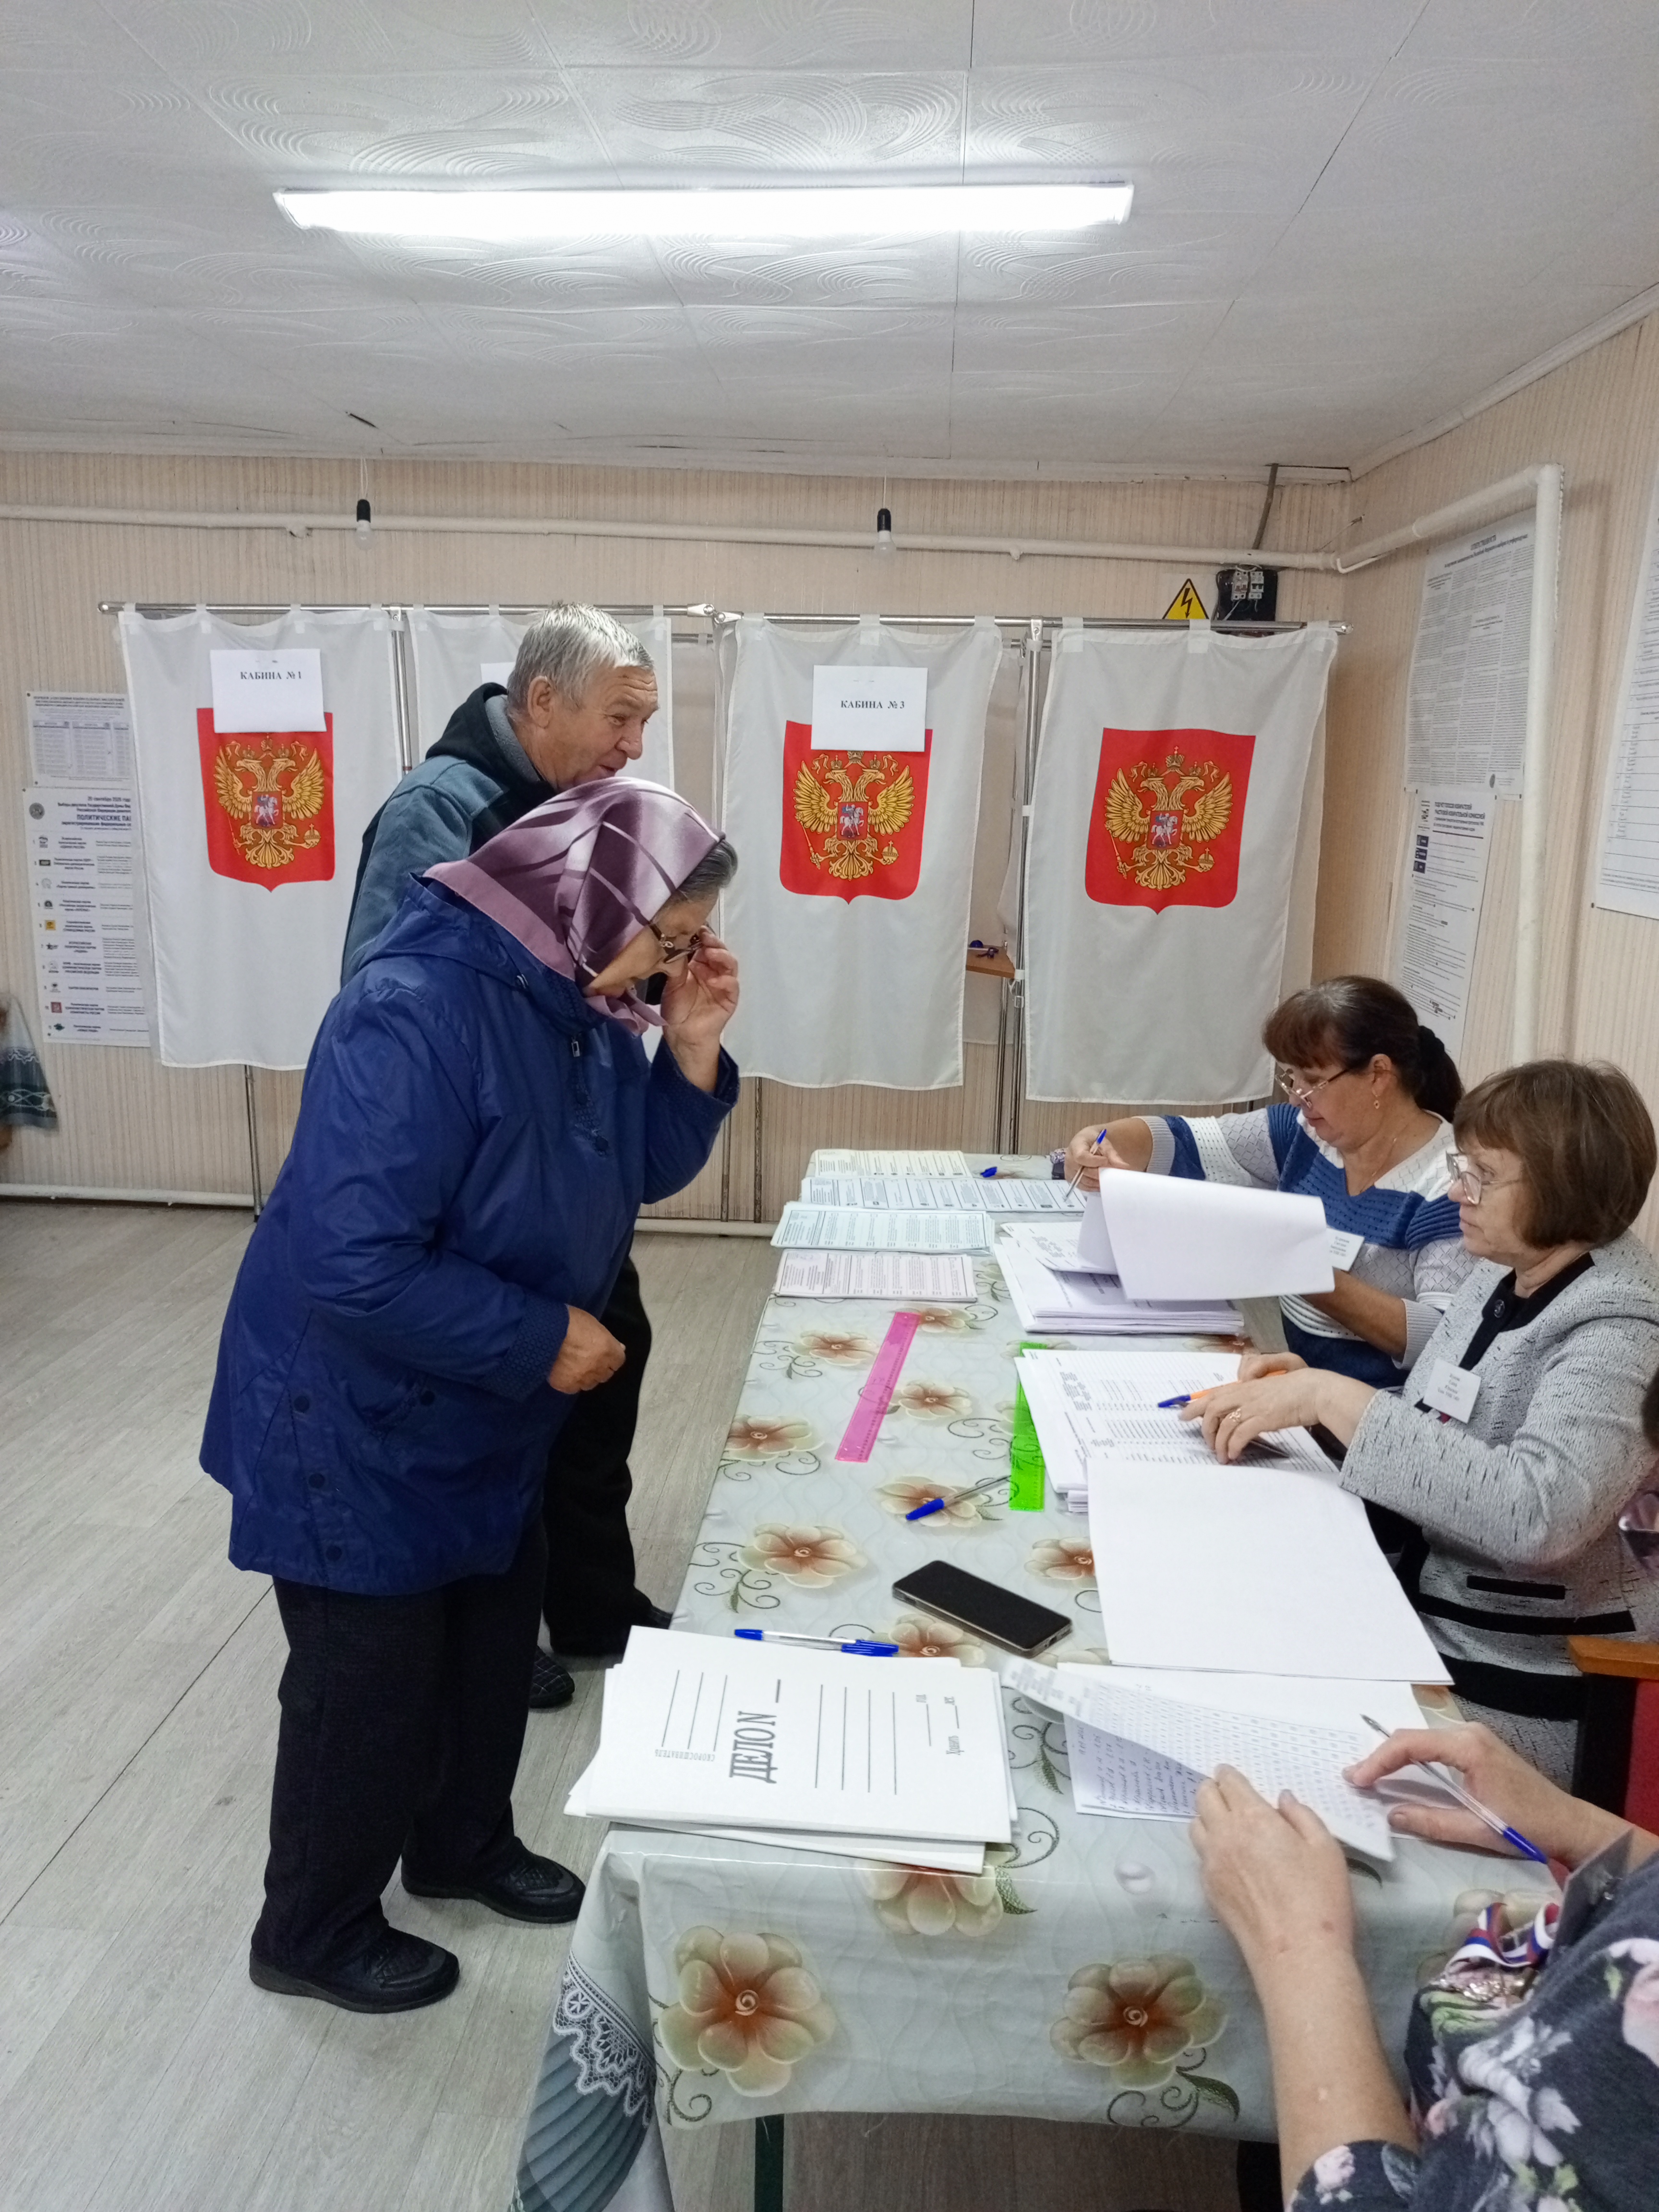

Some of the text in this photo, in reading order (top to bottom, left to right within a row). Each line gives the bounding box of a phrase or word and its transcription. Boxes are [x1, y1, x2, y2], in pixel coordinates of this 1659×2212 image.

[298, 671, 301, 679] 1
[841, 700, 905, 709] КАБИНА № 3
[655, 1749, 715, 1762] СКОРОСШИВАТЕЛЬ
[729, 1728, 778, 1784] ДЕЛО
